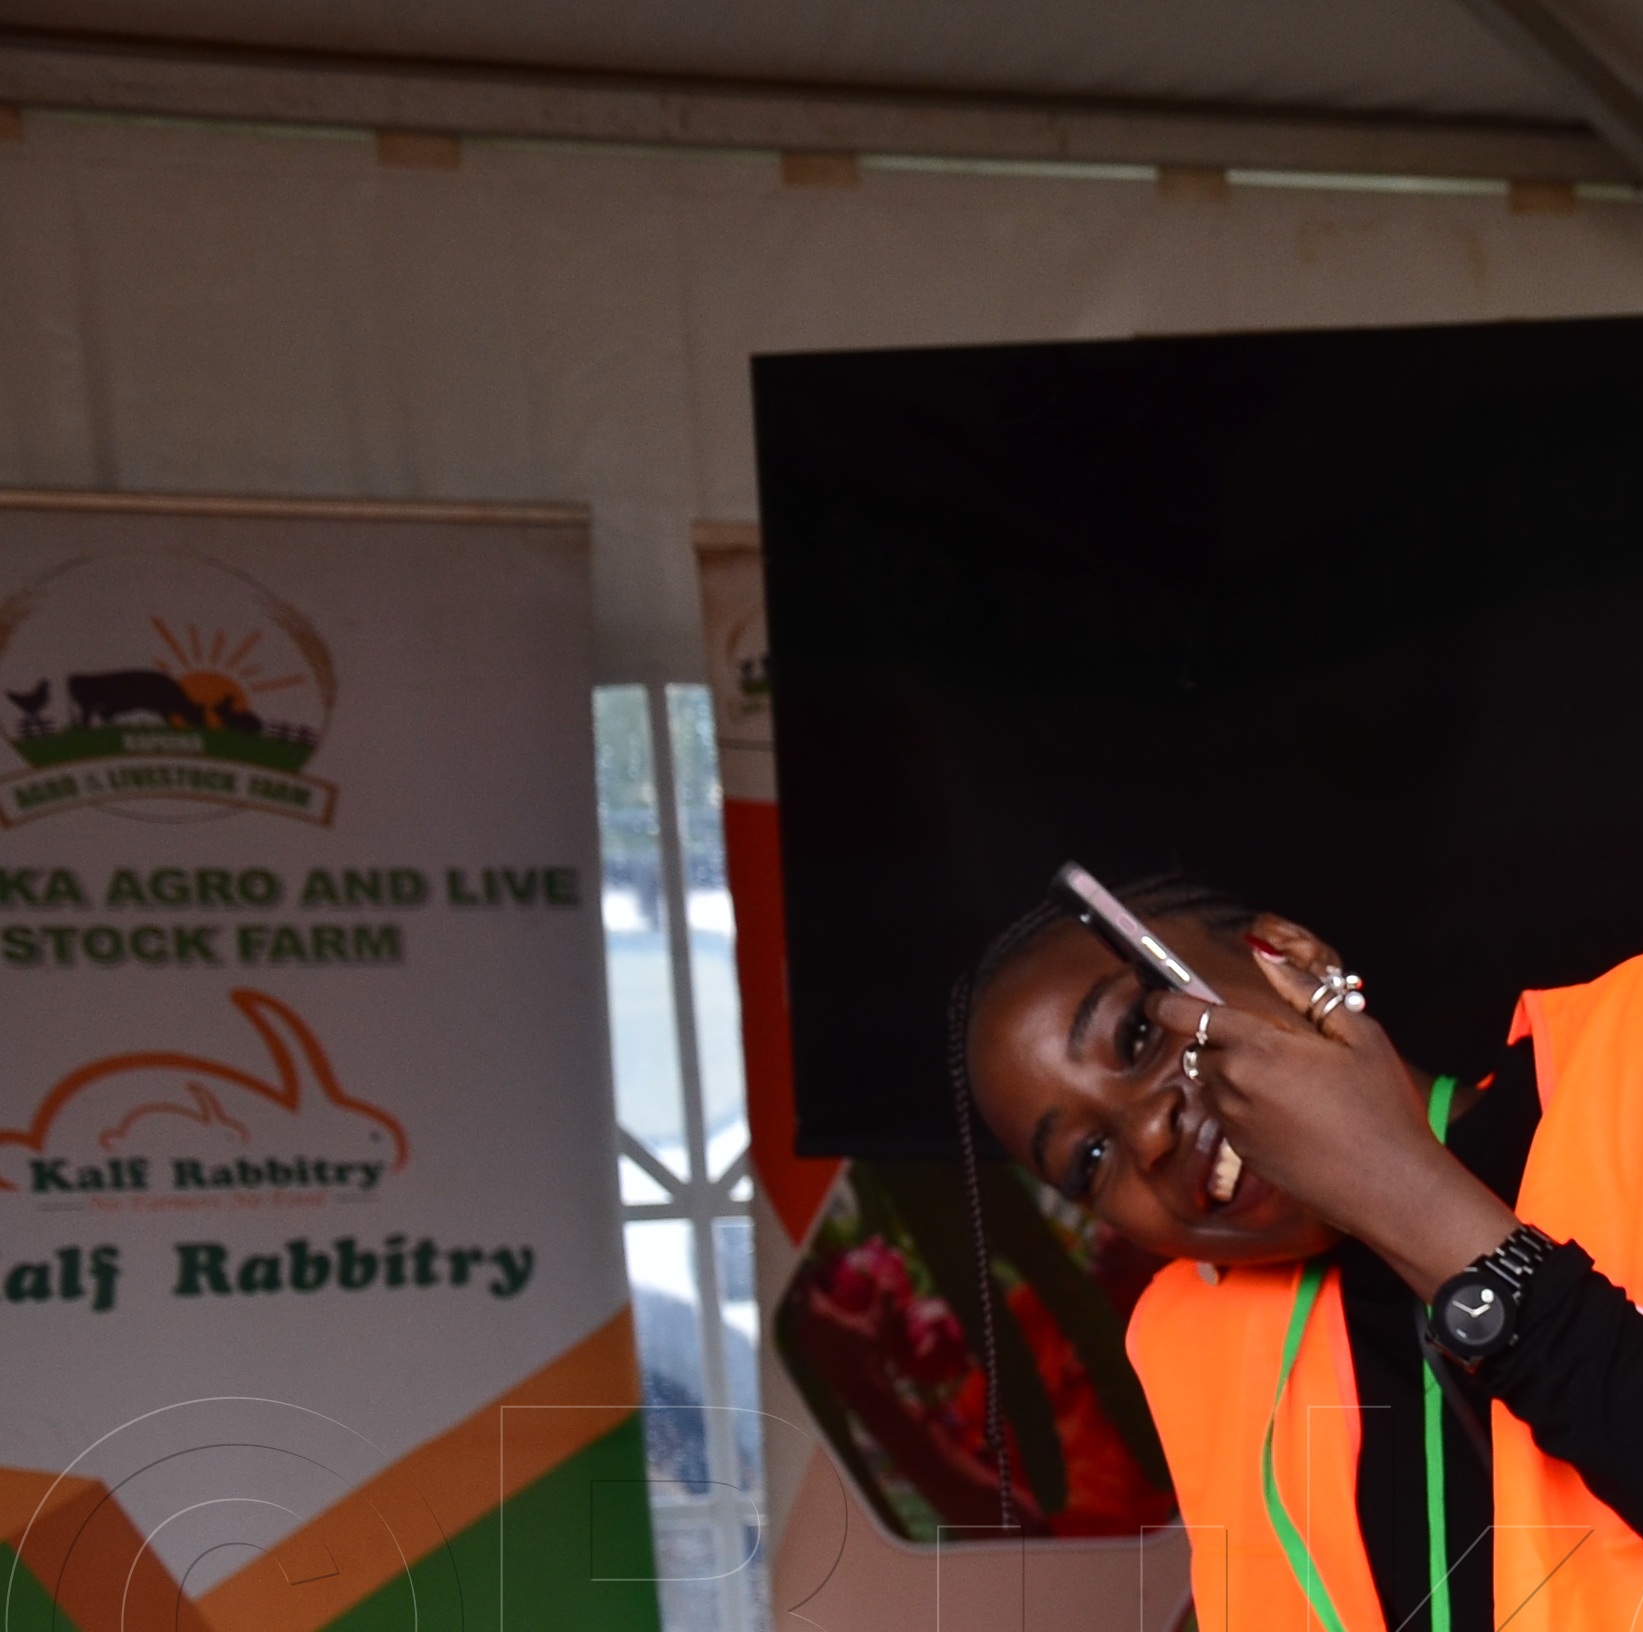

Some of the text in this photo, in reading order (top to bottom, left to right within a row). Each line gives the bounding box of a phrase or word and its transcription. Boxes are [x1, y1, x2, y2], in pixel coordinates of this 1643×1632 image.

[106, 867, 280, 907] AGRO
[301, 867, 428, 907] AND
[447, 866, 580, 907] LIVE
[3, 925, 403, 966] STOCK FARM
[28, 1153, 385, 1193] Kalf Rabbitry
[173, 1235, 534, 1299] Rabbitry
